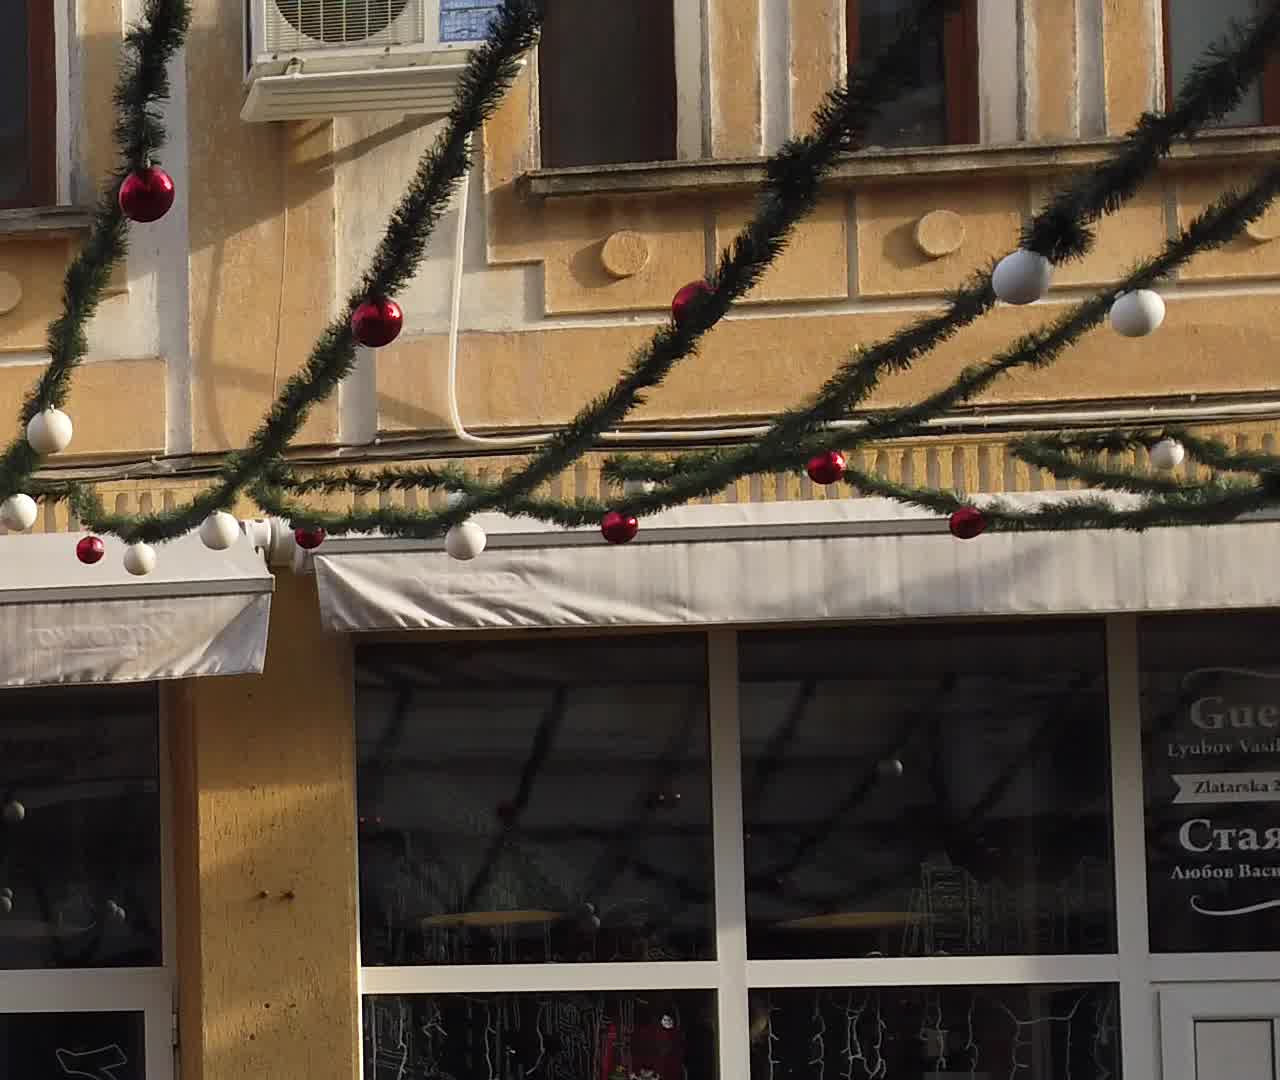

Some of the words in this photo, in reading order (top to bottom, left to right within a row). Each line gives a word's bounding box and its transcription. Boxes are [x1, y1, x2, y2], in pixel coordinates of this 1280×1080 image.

[1191, 696, 1279, 729] Gue
[1168, 738, 1233, 759] Lyubov
[1193, 779, 1269, 795] Zlatarska
[1179, 818, 1280, 852] Стая
[1170, 864, 1234, 880] Любов
